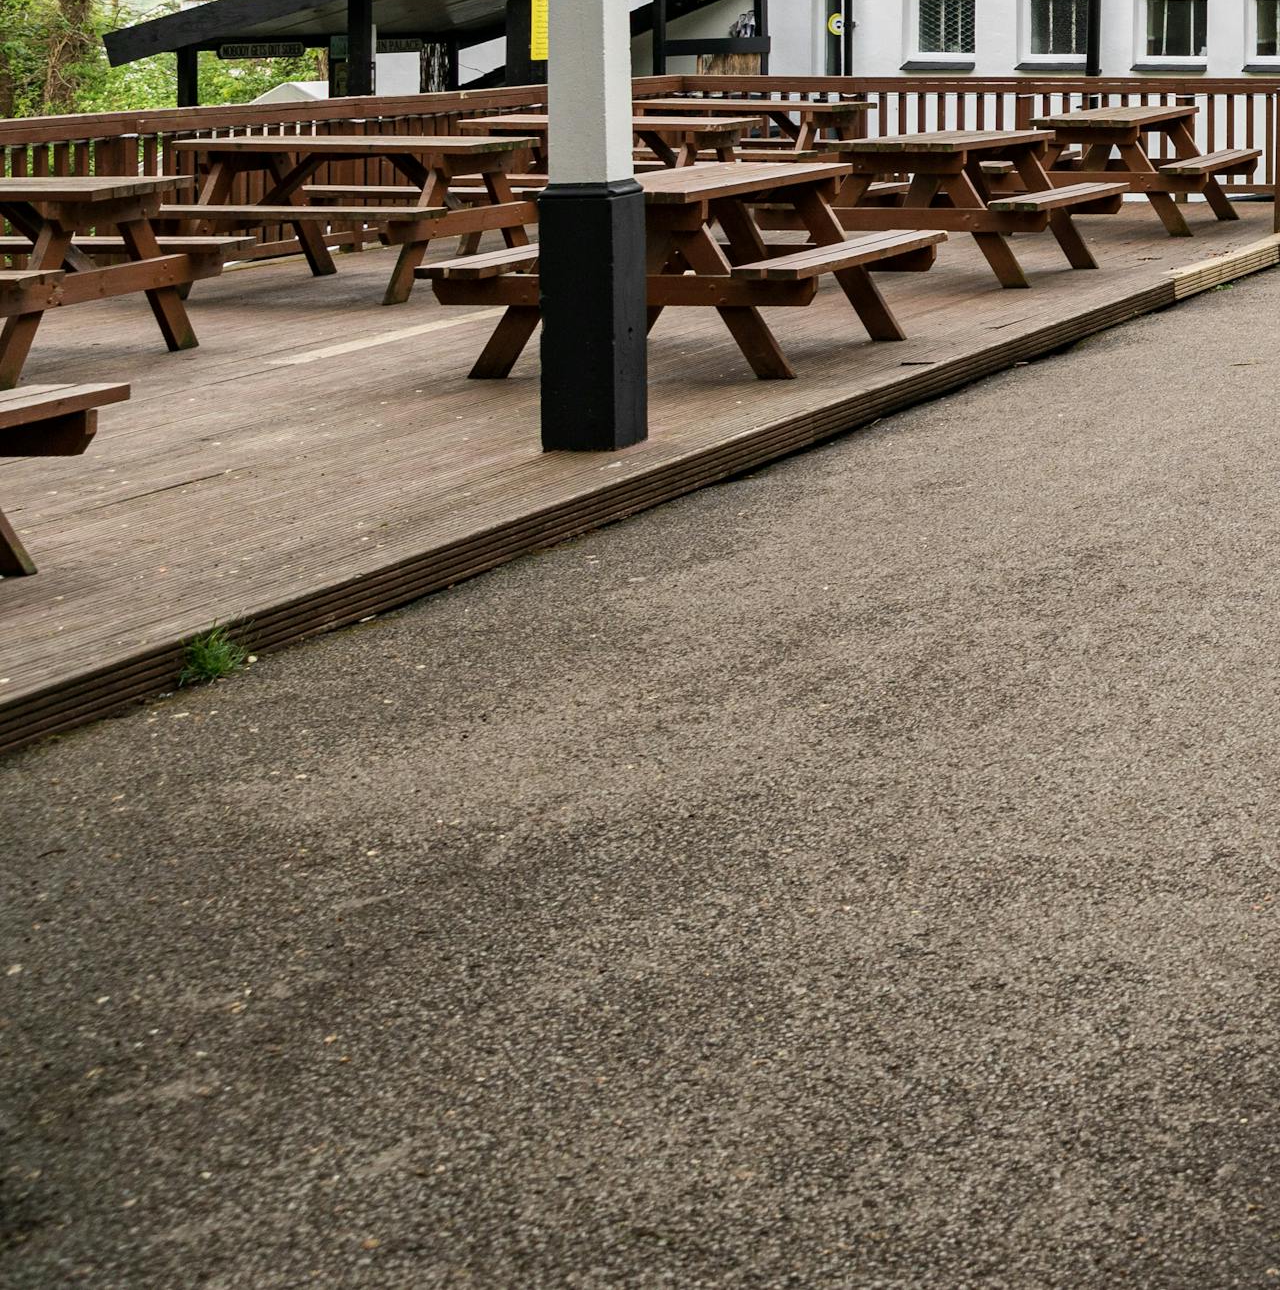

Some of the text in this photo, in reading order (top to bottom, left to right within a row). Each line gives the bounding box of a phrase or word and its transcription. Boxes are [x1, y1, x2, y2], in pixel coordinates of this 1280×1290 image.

[223, 44, 302, 57] NOBODY GETS OUT SOBER
